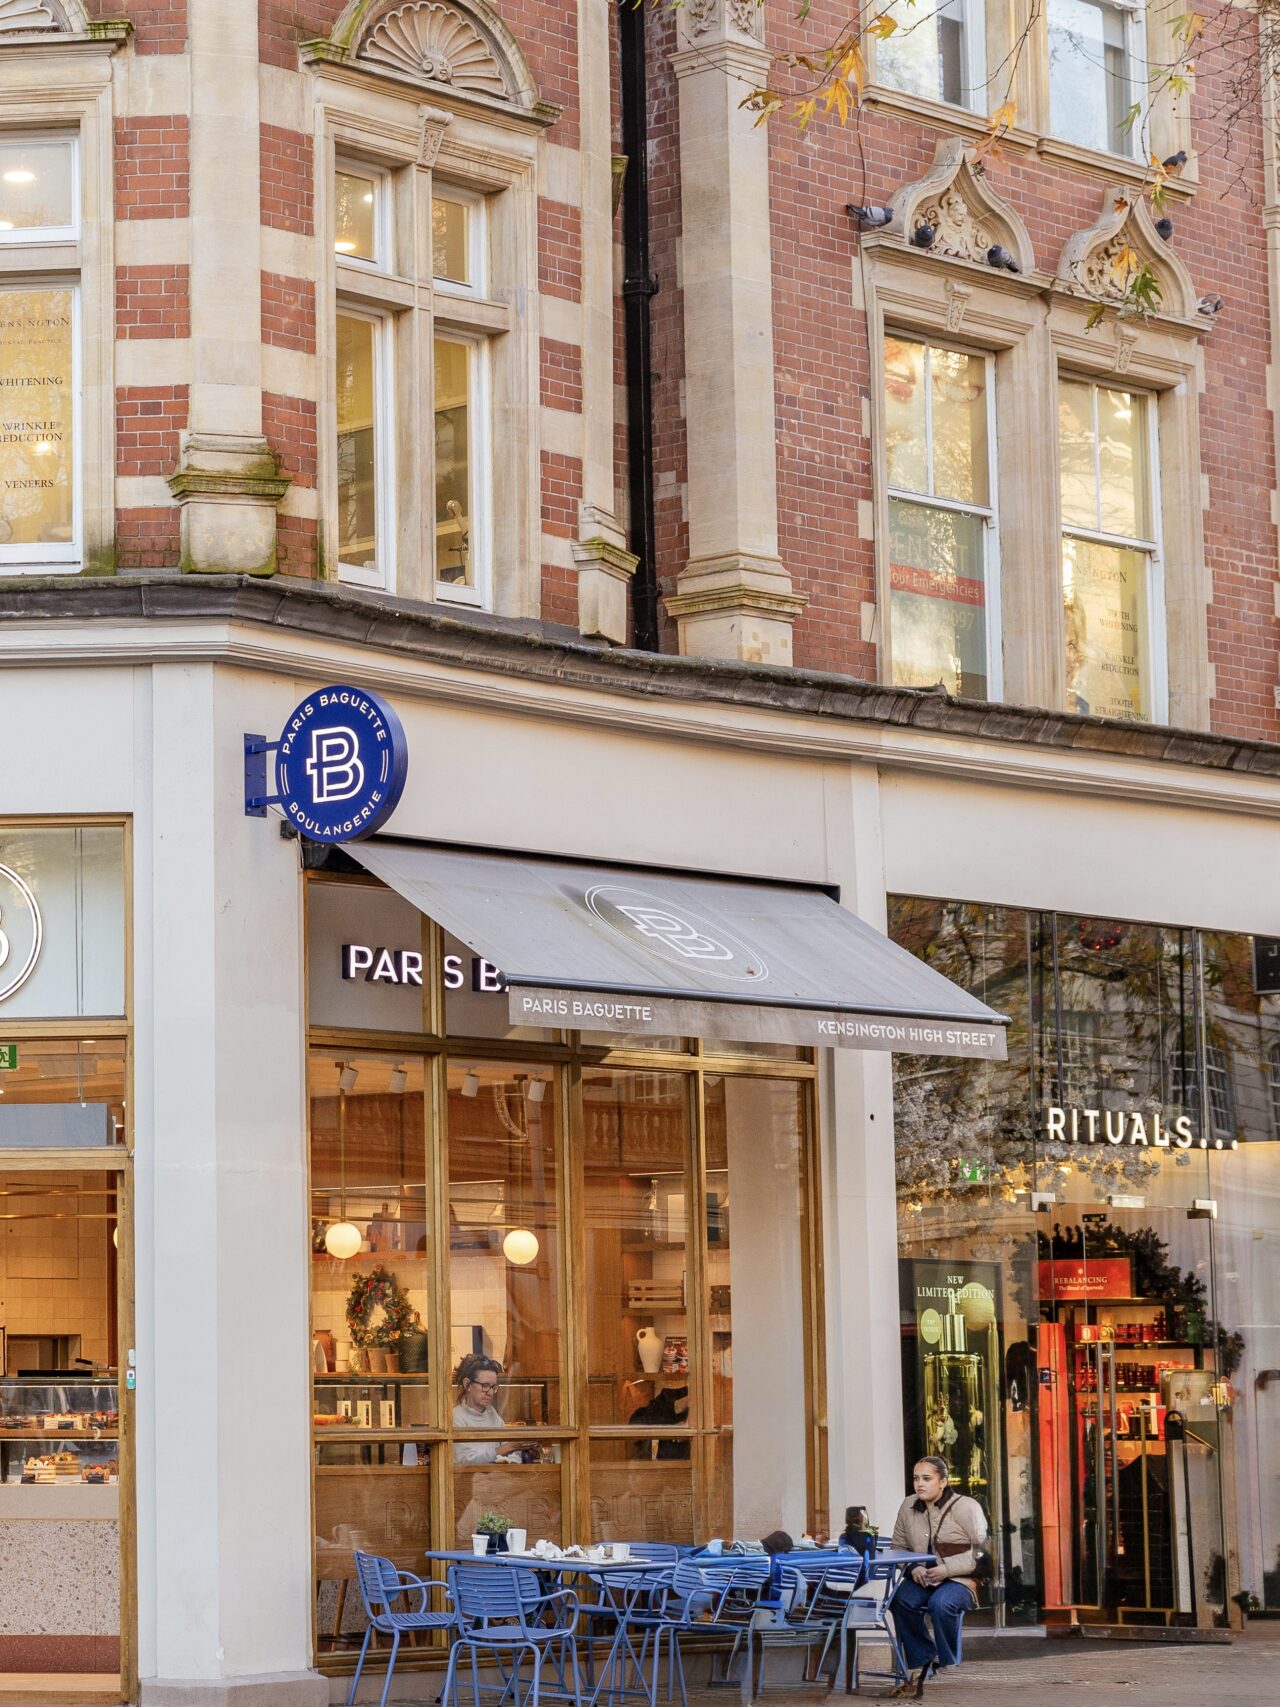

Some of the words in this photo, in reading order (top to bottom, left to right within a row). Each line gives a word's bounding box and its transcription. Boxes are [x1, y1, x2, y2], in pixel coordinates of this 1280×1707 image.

[2, 421, 56, 431] WRINKLE
[4, 479, 54, 489] VENEERS
[912, 571, 980, 600] Emergencies
[1107, 608, 1130, 621] TOOTH
[1099, 618, 1138, 633] WHITENING
[1101, 663, 1140, 677] REDUCTION
[1111, 697, 1133, 709] TOOTH
[1094, 705, 1149, 722] STRAIGHTENING
[282, 704, 314, 754] PARIS
[320, 692, 387, 742] BAGUETTE
[289, 790, 382, 836] BOULANGERIE
[342, 944, 464, 989] PARS
[522, 997, 568, 1015] PARIS
[572, 1001, 652, 1021] BAGUETTE
[817, 1020, 906, 1041] KENSINGTON
[909, 1027, 943, 1044] HIGH
[946, 1030, 996, 1047] STREET
[946, 1275, 965, 1285] NEW
[1054, 1276, 1108, 1285] REBALANCING
[916, 1286, 955, 1298] LIMITED
[957, 1287, 995, 1299] EDITION
